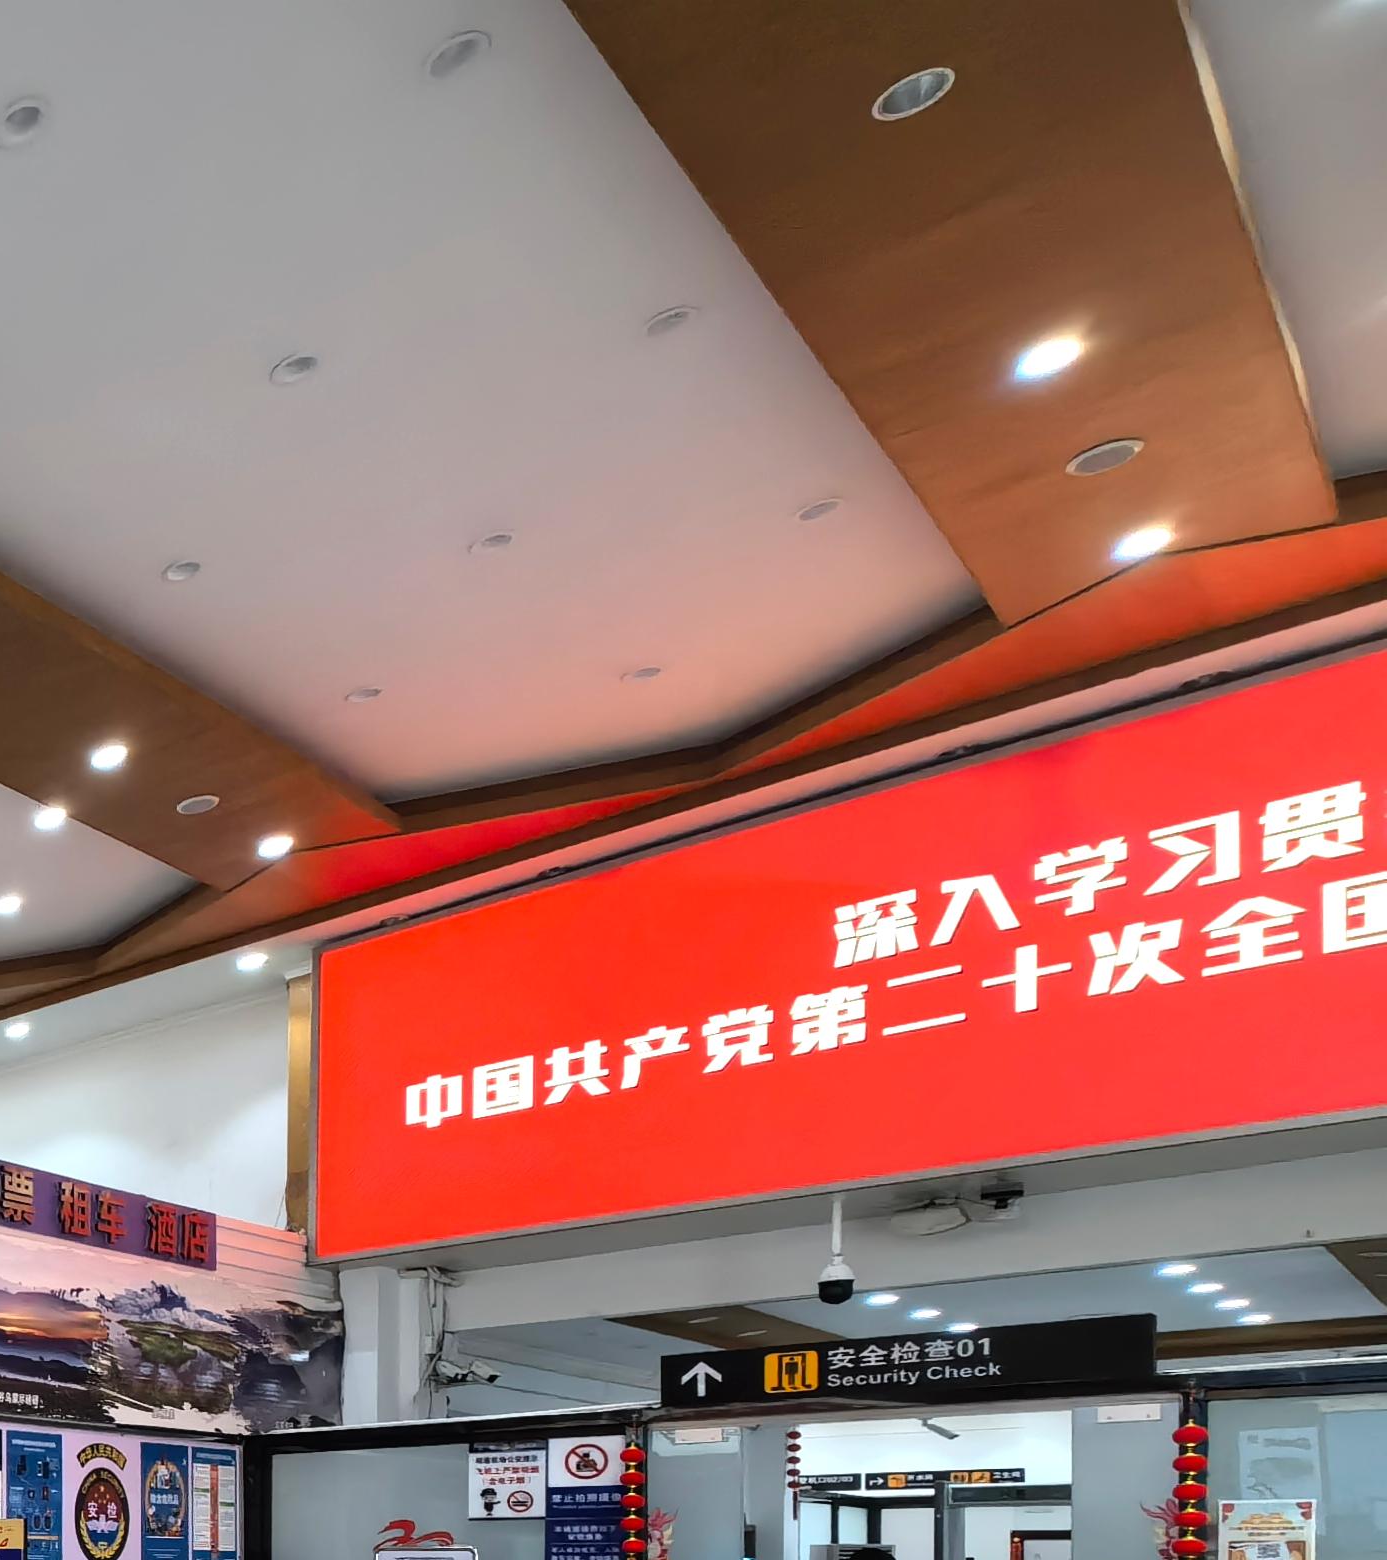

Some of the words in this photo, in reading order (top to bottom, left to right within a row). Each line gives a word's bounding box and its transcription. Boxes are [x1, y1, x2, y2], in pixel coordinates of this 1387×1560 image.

[404, 870, 1387, 1130] 中国共产党第二十次全国
[57, 1180, 128, 1245] 租车
[146, 1200, 210, 1263] 酒店
[826, 1337, 992, 1370] 安全检查01
[827, 1369, 920, 1387] Security
[926, 1362, 1002, 1380] Check
[87, 1501, 119, 1519] 安检
